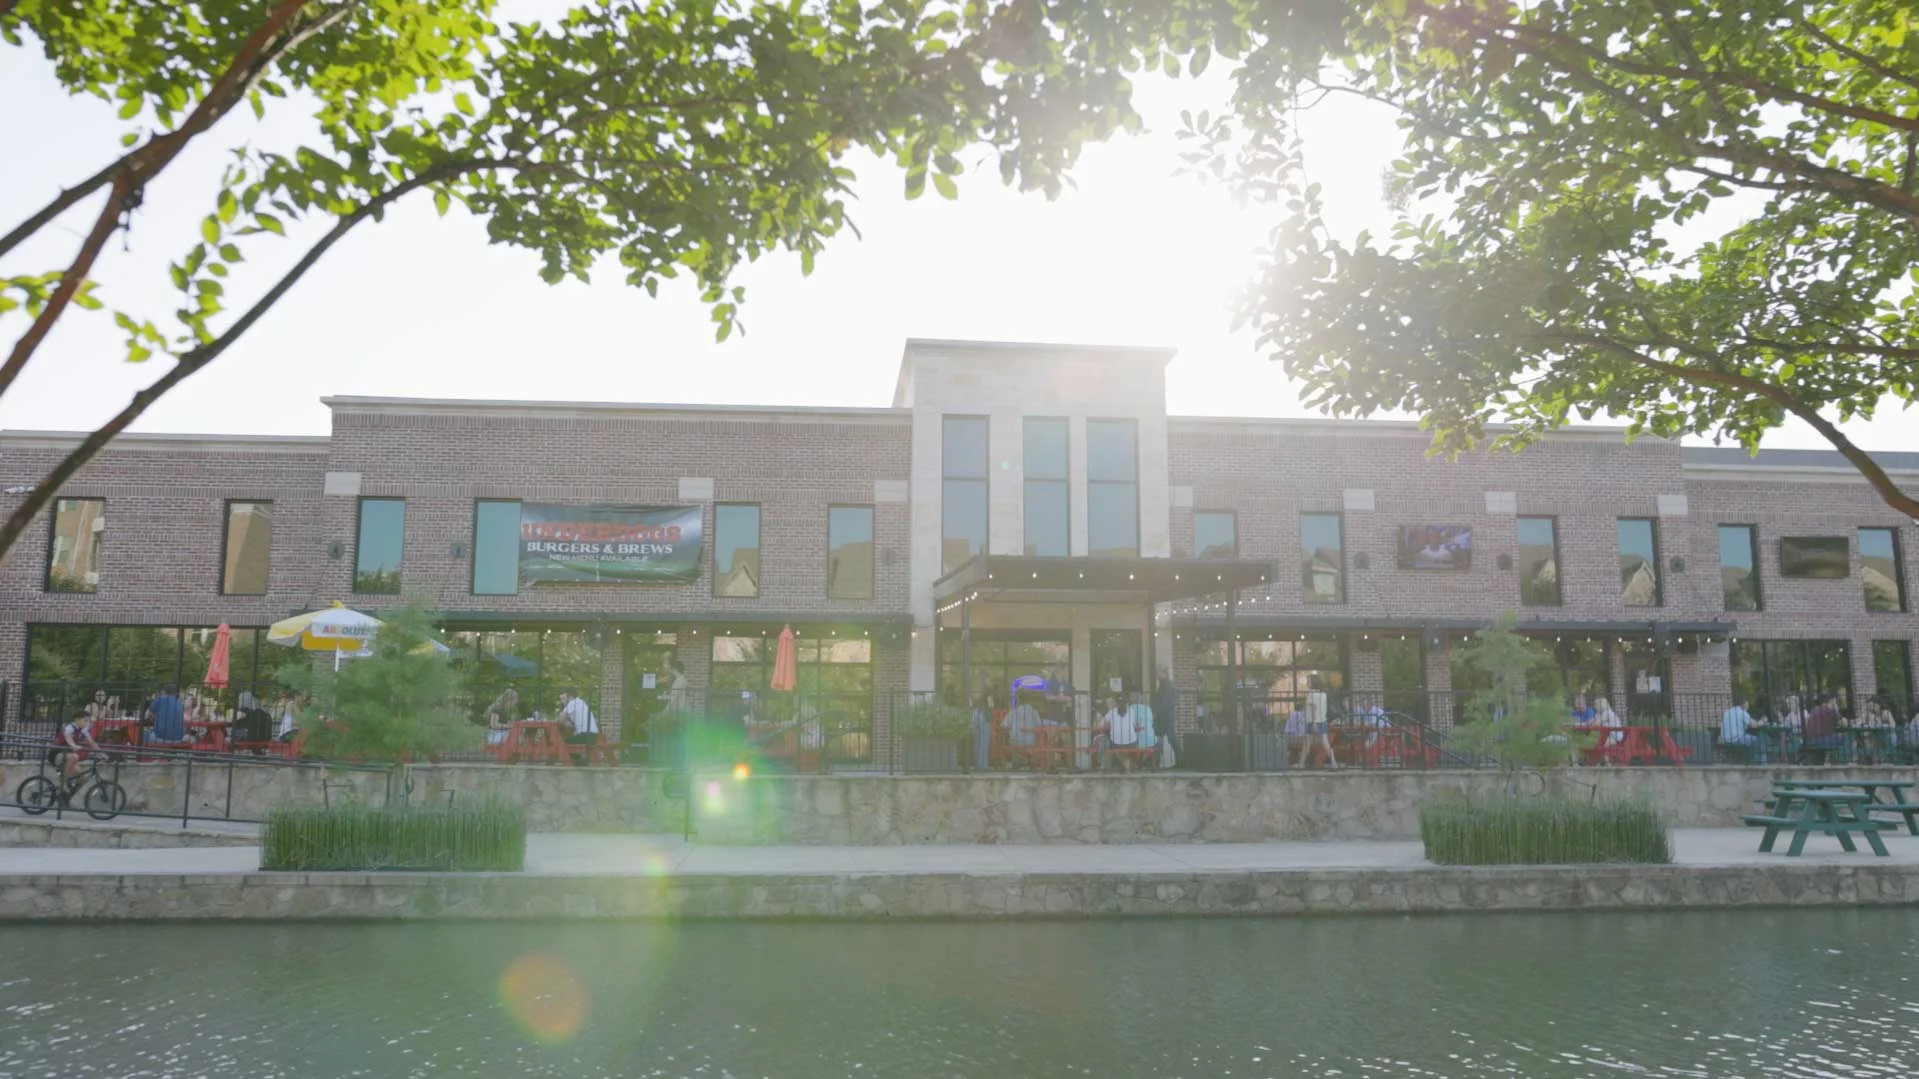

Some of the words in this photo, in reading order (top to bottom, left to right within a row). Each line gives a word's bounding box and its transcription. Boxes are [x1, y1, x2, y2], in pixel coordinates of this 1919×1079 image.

[526, 542, 600, 553] BURGERS
[603, 543, 615, 554] &
[618, 543, 673, 555] BREWS
[549, 553, 570, 561] NEW
[600, 554, 648, 562] AVAILABLE
